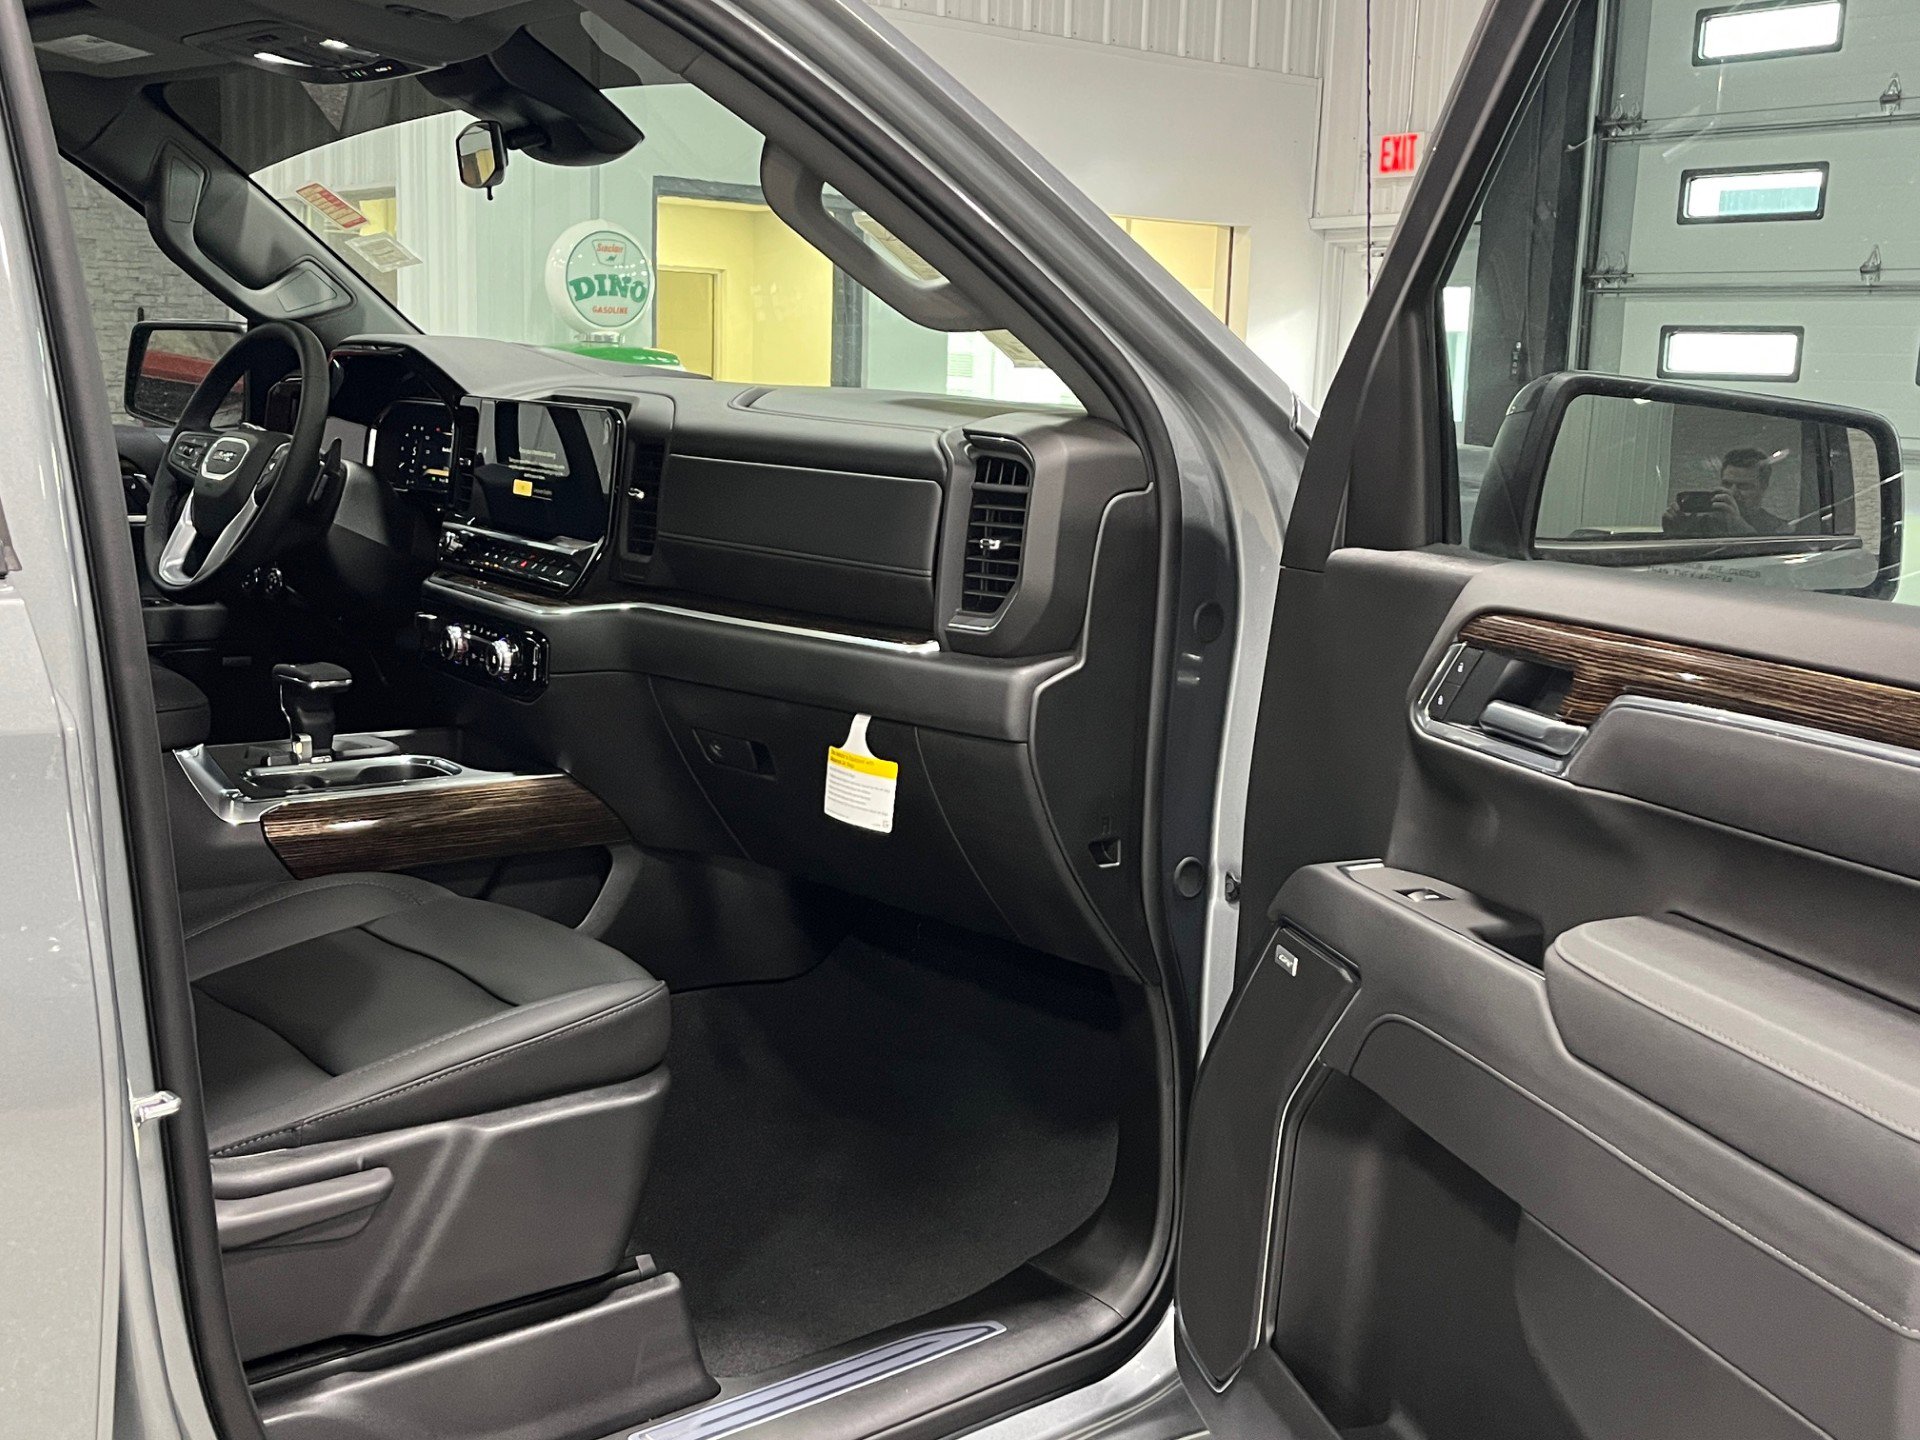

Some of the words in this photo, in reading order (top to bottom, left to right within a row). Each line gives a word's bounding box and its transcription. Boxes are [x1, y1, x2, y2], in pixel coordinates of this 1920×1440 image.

[1381, 133, 1417, 172] EXIT
[568, 274, 648, 303] DINO
[592, 306, 628, 315] GASOLINE
